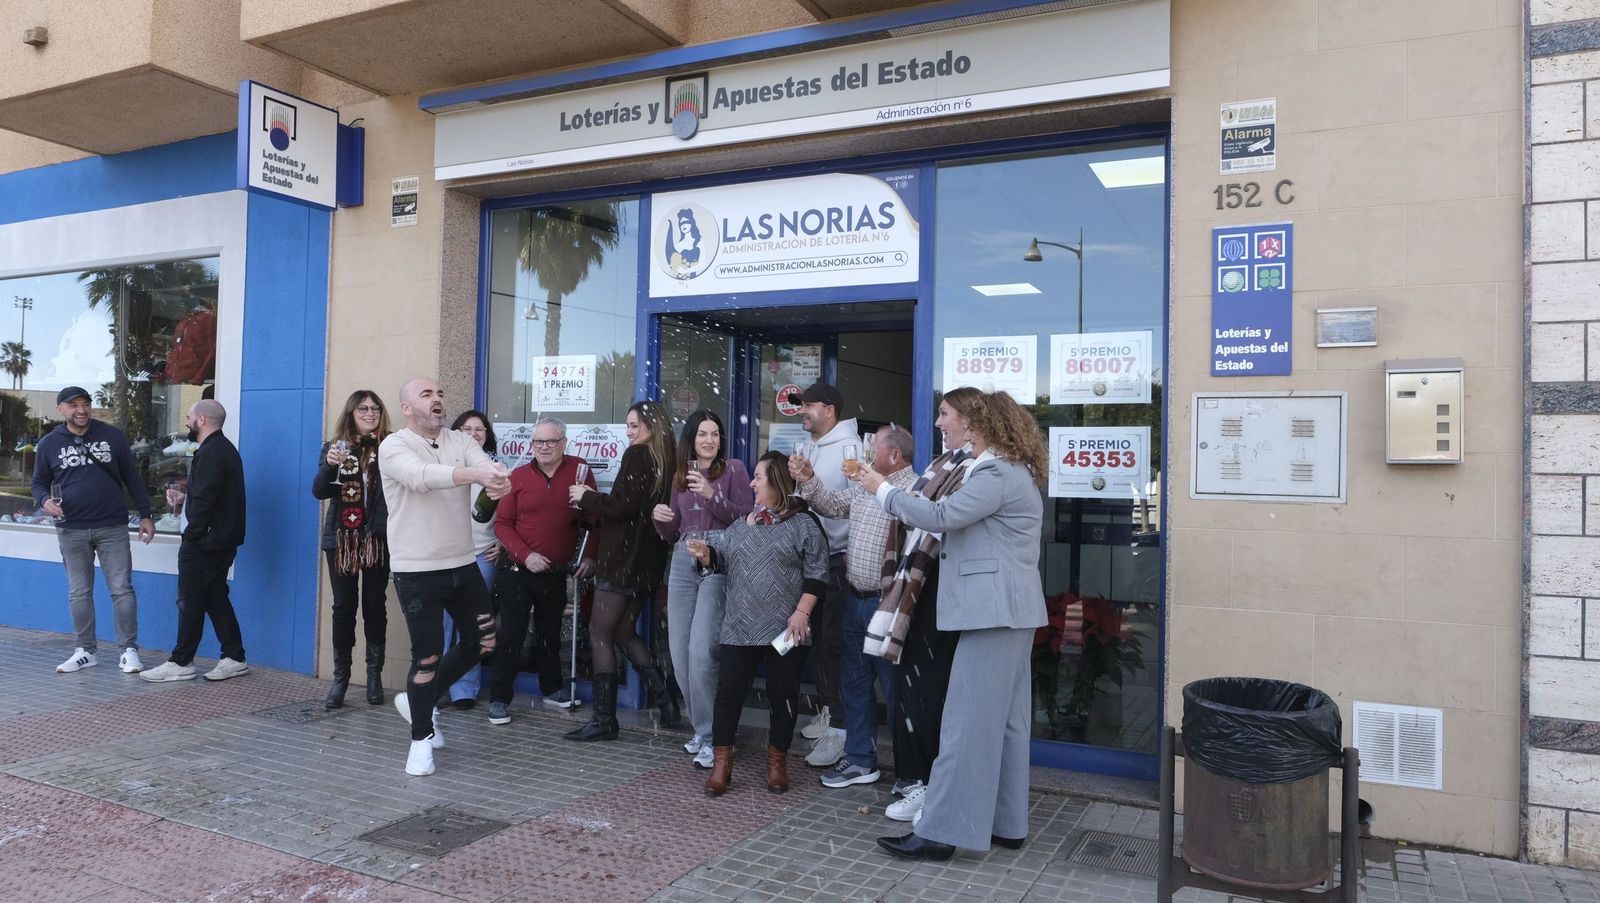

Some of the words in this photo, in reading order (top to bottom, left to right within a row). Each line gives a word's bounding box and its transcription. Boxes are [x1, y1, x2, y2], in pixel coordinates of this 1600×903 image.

[560, 102, 642, 131] Loterías
[648, 102, 660, 124] y
[712, 77, 822, 112] Apuestas
[831, 63, 869, 91] del
[878, 50, 971, 85] Estado
[876, 102, 951, 120] Administración
[1224, 127, 1272, 140] Alarma
[262, 149, 299, 168] Loterías
[300, 162, 306, 171] y
[262, 161, 304, 180] Apuestas
[306, 174, 319, 185] del
[262, 172, 293, 189] Estado
[1213, 181, 1262, 210] 152
[1275, 179, 1295, 205] C
[722, 213, 773, 243] LAS
[779, 202, 896, 238] NORIAS
[722, 238, 807, 255] ADMINISTRACIÓN
[810, 237, 822, 247] DE
[825, 231, 868, 246] LOTERÍA
[719, 255, 884, 275] WWW.ADMINISTRACIONLASNORIAS.COM
[1215, 326, 1262, 339] Loterías
[1264, 328, 1271, 339] y
[972, 346, 1018, 357] PREMIO
[1081, 345, 1131, 357] PREMIO
[1215, 343, 1267, 356] Apuestas
[1270, 342, 1288, 353] del
[956, 357, 1023, 374] 88979
[1065, 357, 1136, 374] 86007
[1215, 360, 1254, 370] Estado
[551, 380, 584, 389] PREMIO
[502, 440, 533, 456] 6062
[575, 442, 617, 458] 77768
[1079, 439, 1131, 450] PREMIO
[1062, 451, 1136, 468] 45353
